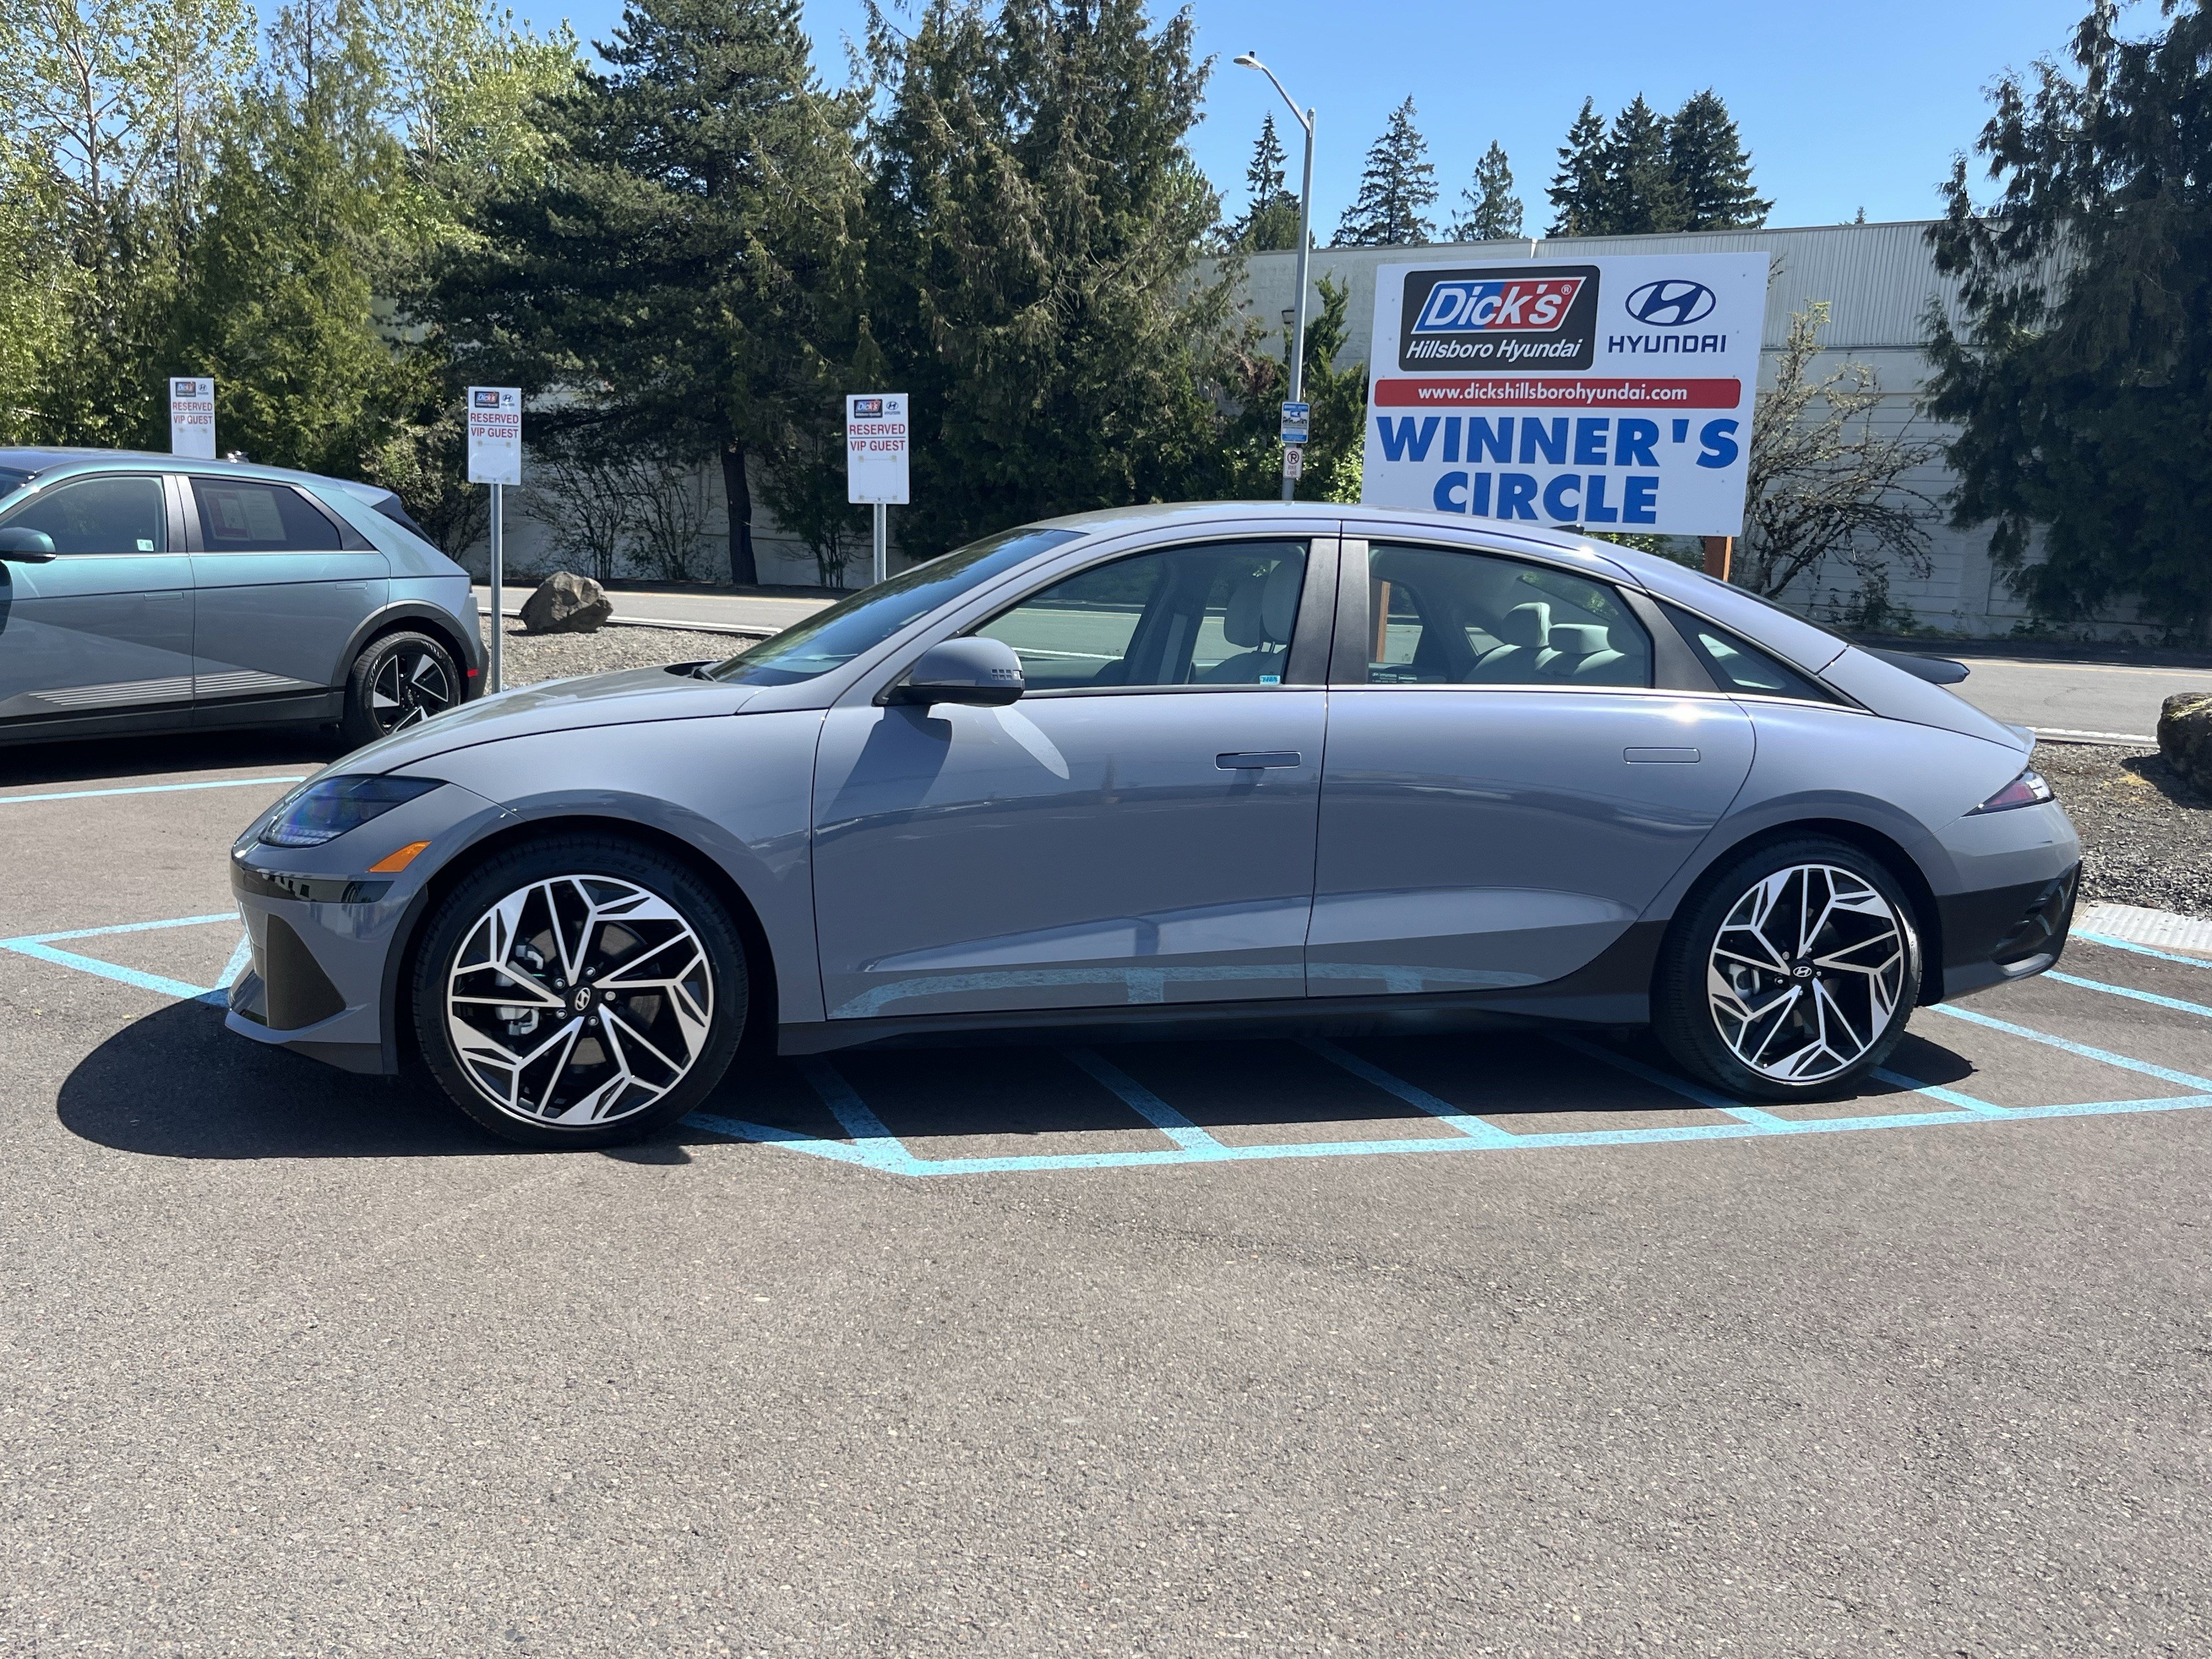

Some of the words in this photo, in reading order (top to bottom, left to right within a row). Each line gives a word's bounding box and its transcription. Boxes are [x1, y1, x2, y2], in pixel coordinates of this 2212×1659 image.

[1424, 284, 1562, 326] Dick's
[1405, 340, 1494, 359] Hillsboro
[1496, 338, 1584, 363] Hyundai
[1608, 334, 1726, 353] HYUNDAI
[1418, 381, 1687, 404] www.dickshillsborohyundai.com
[172, 402, 213, 411] RESERVED
[173, 415, 185, 424] VIP
[187, 415, 213, 424] GUEST
[470, 413, 519, 424] RESERVED
[470, 427, 485, 437] VIP
[488, 427, 519, 438] GUEST
[849, 424, 906, 435] RESERVED
[850, 441, 866, 451] VIP
[870, 440, 906, 451] GUEST
[1376, 416, 1740, 469] WINNER'S
[1433, 471, 1660, 524] CIRCLE
